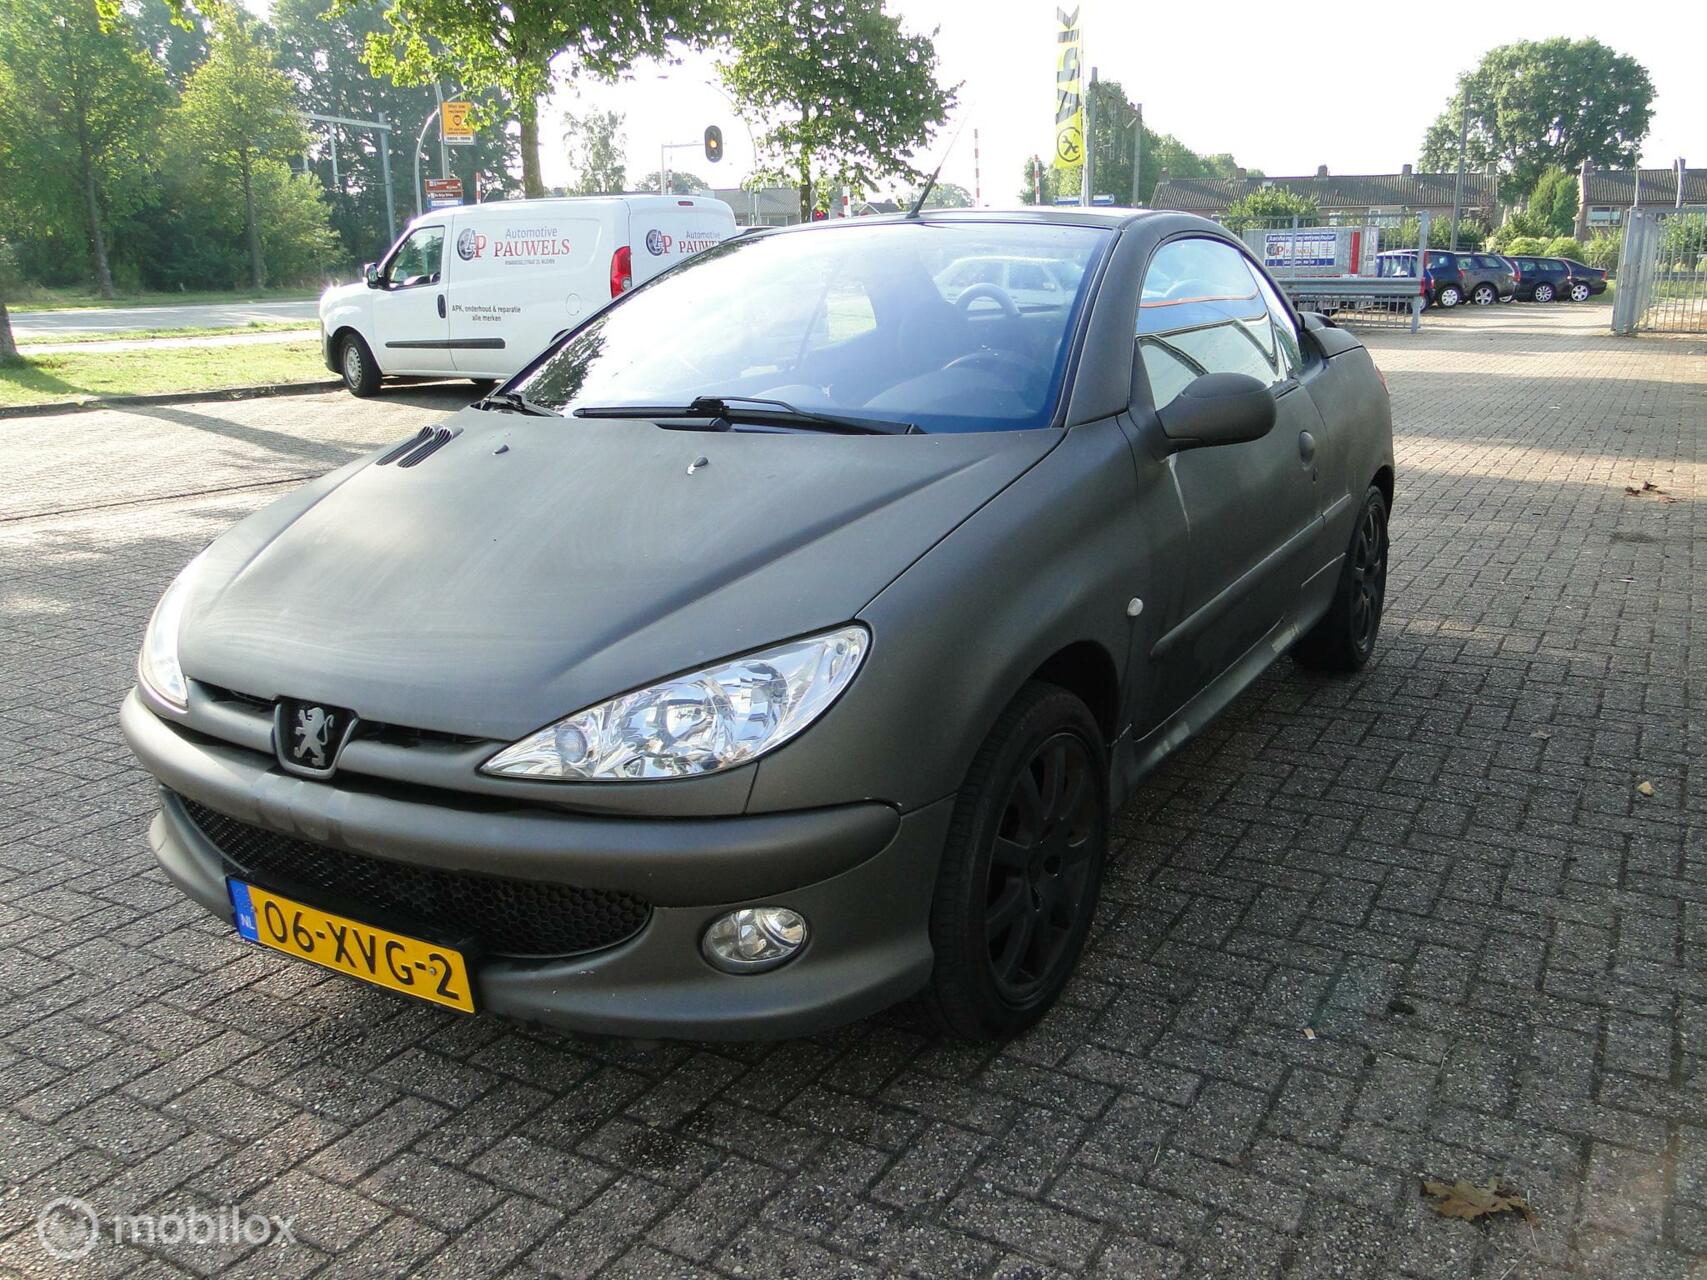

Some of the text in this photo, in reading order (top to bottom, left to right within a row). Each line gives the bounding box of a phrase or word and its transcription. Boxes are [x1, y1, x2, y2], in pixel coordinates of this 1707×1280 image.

[505, 226, 558, 239] Automotive
[686, 231, 721, 240] Automotive
[494, 238, 571, 257] PAUWELS
[498, 305, 521, 313] reparatie
[240, 913, 256, 930] NL
[264, 900, 460, 1001] 06-XVG-2
